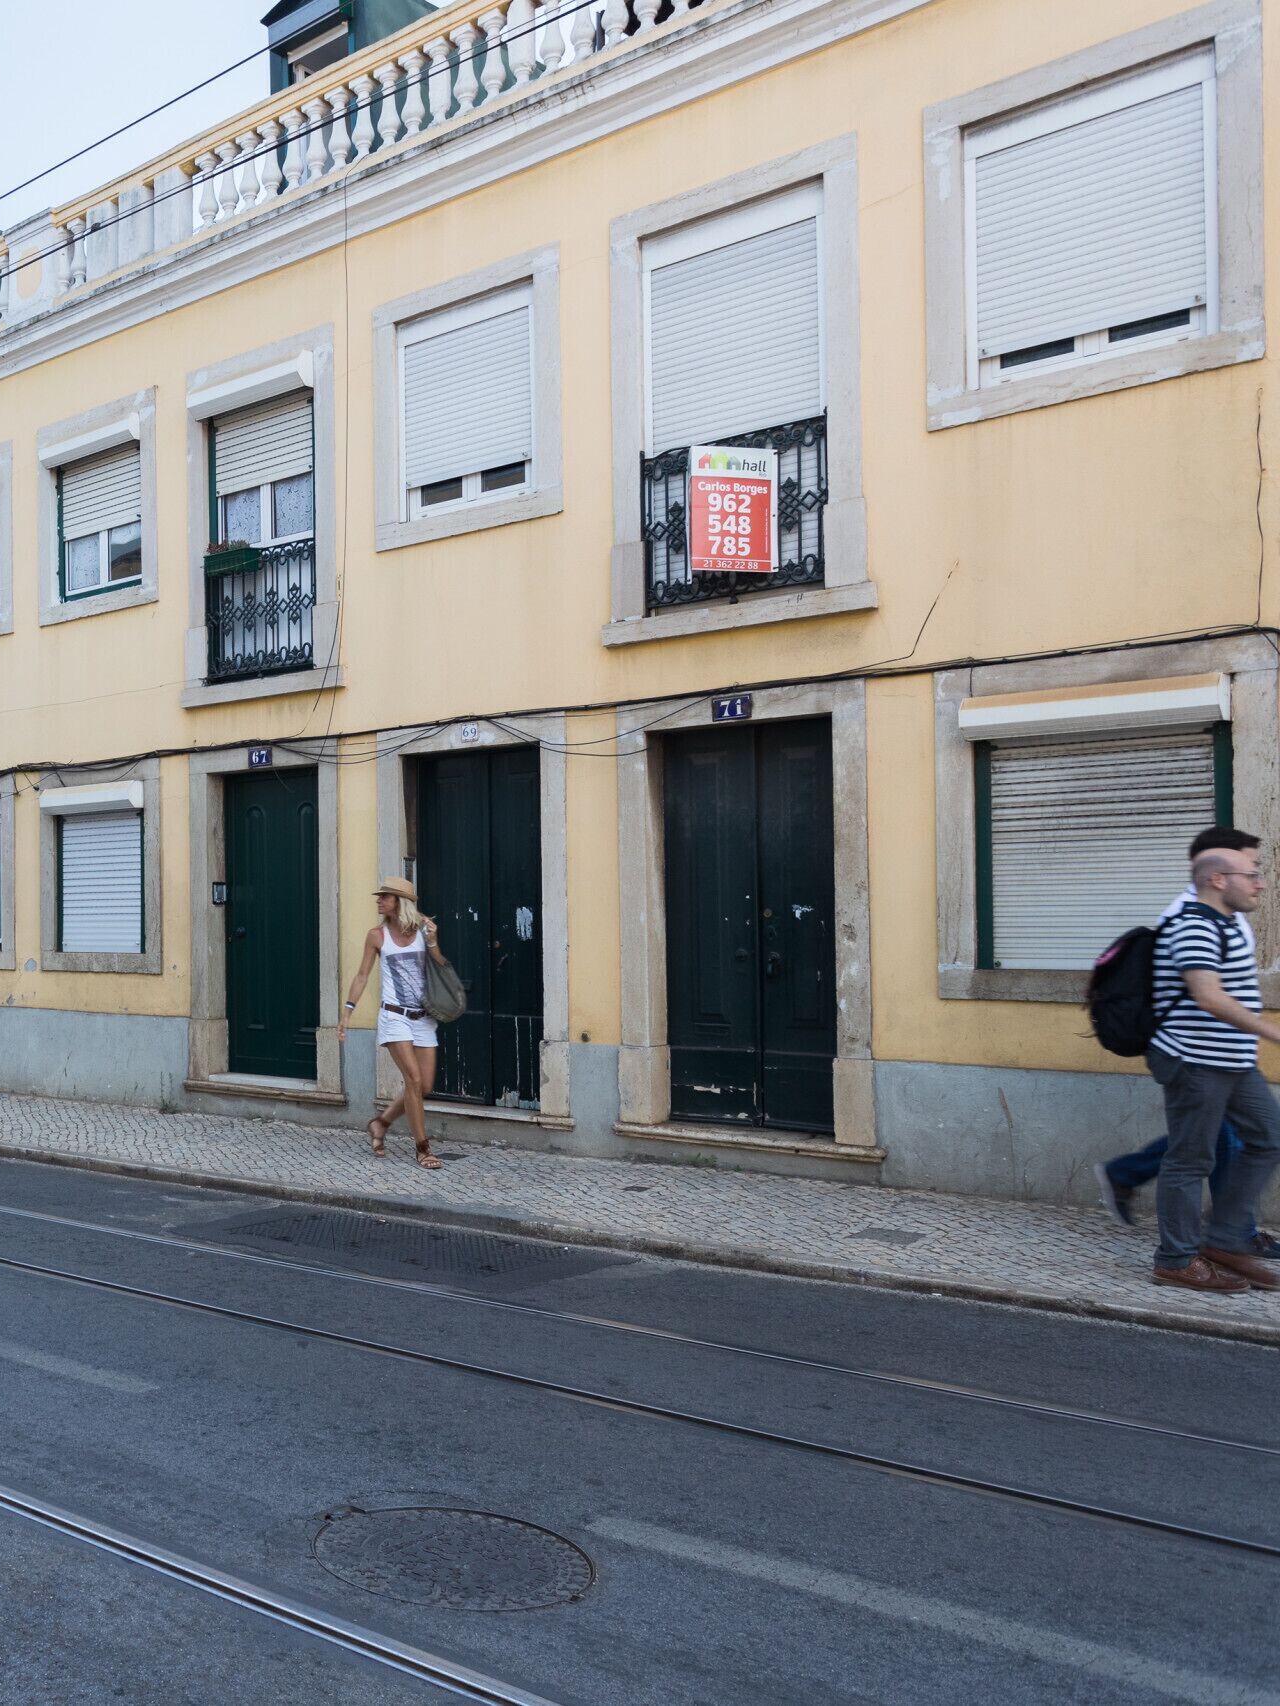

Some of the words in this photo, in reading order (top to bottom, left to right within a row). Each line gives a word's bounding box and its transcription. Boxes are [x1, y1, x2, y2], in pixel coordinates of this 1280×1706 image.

[698, 481, 731, 492] Carlos
[733, 483, 768, 495] Borges
[708, 493, 751, 513] 962
[708, 514, 751, 534] 548
[708, 535, 751, 556] 785
[703, 560, 713, 568] 21
[716, 560, 732, 569] 362
[735, 561, 745, 569] 22
[747, 562, 759, 570] 88
[720, 698, 743, 717] 71
[463, 726, 477, 738] 69
[252, 750, 267, 764] 67
